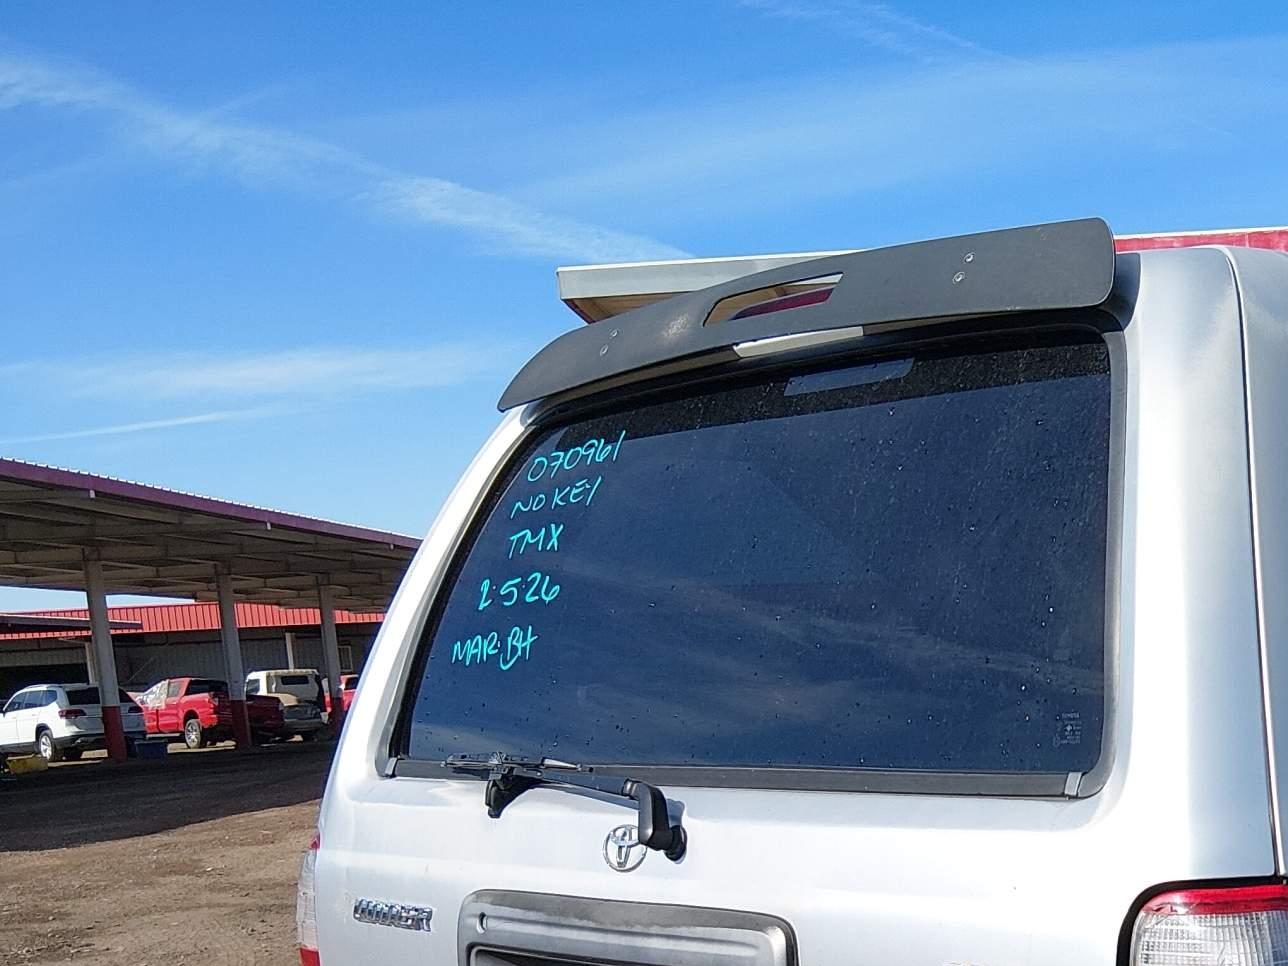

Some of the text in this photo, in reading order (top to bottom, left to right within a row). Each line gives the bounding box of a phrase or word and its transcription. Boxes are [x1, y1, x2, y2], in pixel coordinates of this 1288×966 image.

[527, 429, 626, 482] 070961
[510, 475, 602, 520] NO KEY
[508, 523, 564, 559] TMX
